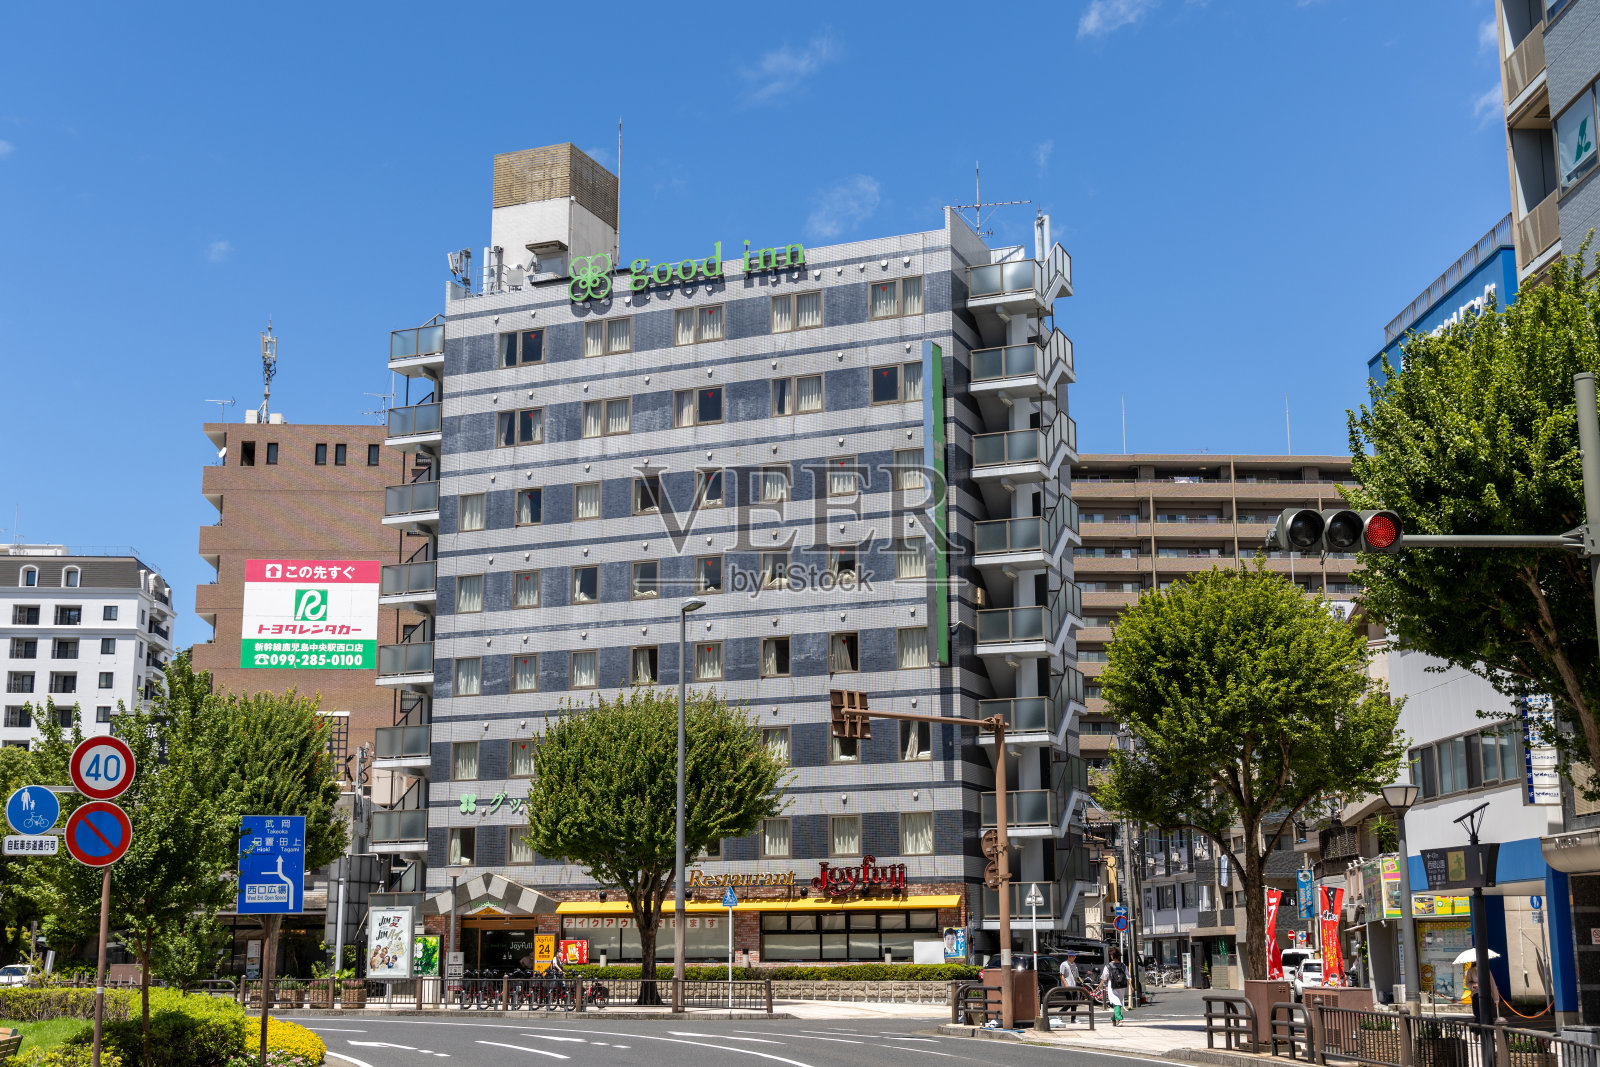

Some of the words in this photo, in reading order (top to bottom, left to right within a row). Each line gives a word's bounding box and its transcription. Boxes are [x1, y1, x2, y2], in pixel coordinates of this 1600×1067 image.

[629, 240, 723, 291] good
[742, 239, 804, 272] inn
[286, 566, 355, 579] この先すぐ
[258, 624, 362, 635] トヨタレンタカー
[254, 643, 363, 652] 新幹線鹿児島中央駅西口店
[270, 654, 363, 666] 099-285-0100
[85, 754, 120, 781] 40
[489, 791, 534, 815] グッ
[688, 868, 797, 888] Restaurant
[810, 854, 907, 897] Joyfull
[247, 885, 287, 895] 西口広場
[509, 941, 533, 951] Joyfull
[538, 944, 551, 954] 24
